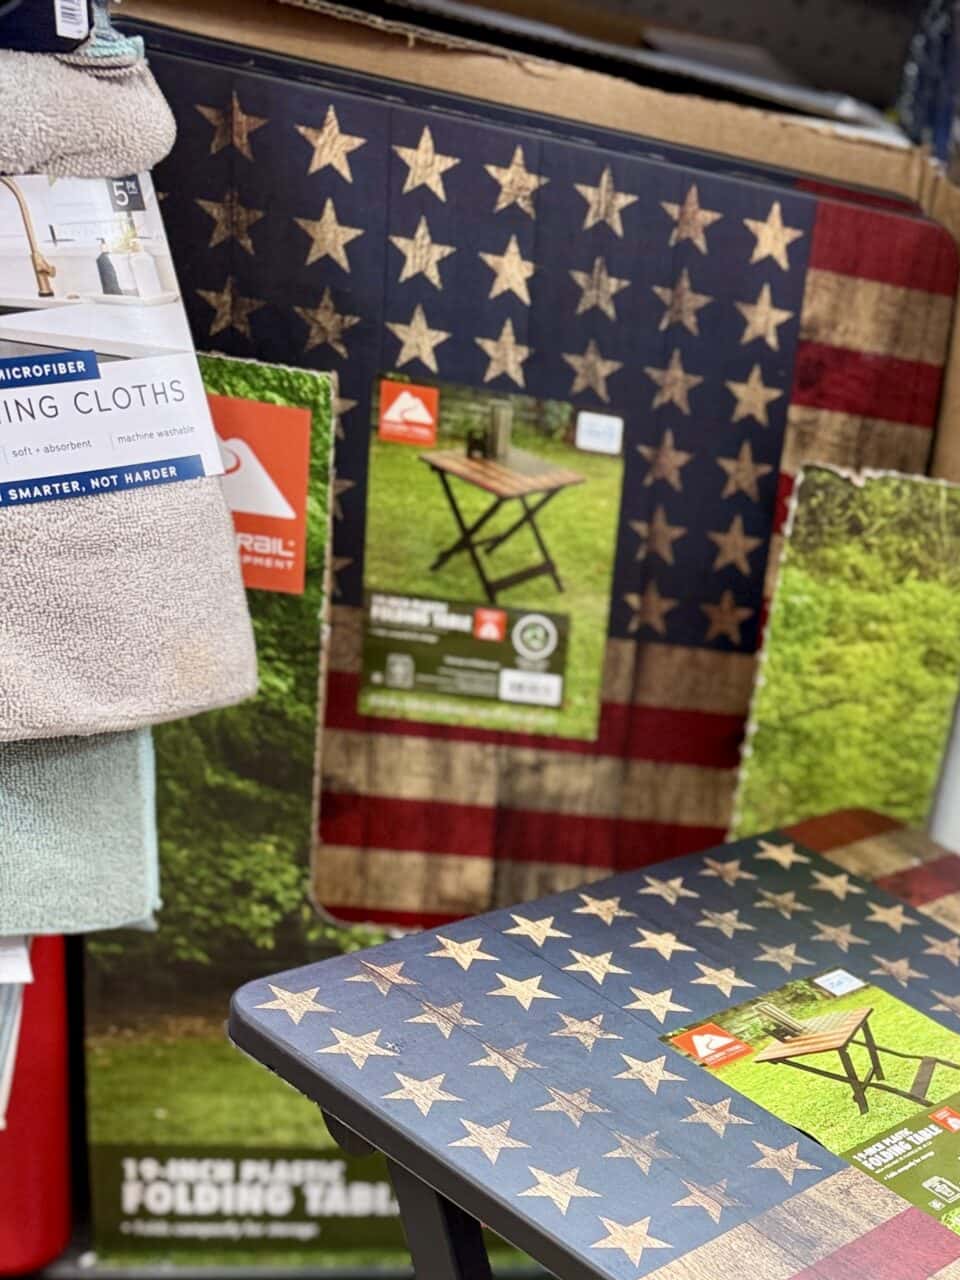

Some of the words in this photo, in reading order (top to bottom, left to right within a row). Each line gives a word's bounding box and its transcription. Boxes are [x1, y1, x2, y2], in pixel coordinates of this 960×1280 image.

[112, 181, 129, 206] 5
[0, 395, 60, 425] ING
[73, 379, 186, 415] CLOTHS
[12, 446, 33, 458] soft
[43, 439, 92, 454] absorbent
[117, 430, 154, 444] machine
[157, 424, 196, 439] washable
[8, 481, 87, 501] SMARTER,
[90, 475, 119, 492] NOT
[124, 466, 178, 485] HARDER
[236, 533, 296, 558] RAIL
[861, 1140, 913, 1171] FOLDING
[906, 1123, 943, 1146] TABLE
[120, 1180, 294, 1216] FOLDING
[302, 1181, 400, 1217] TABL
